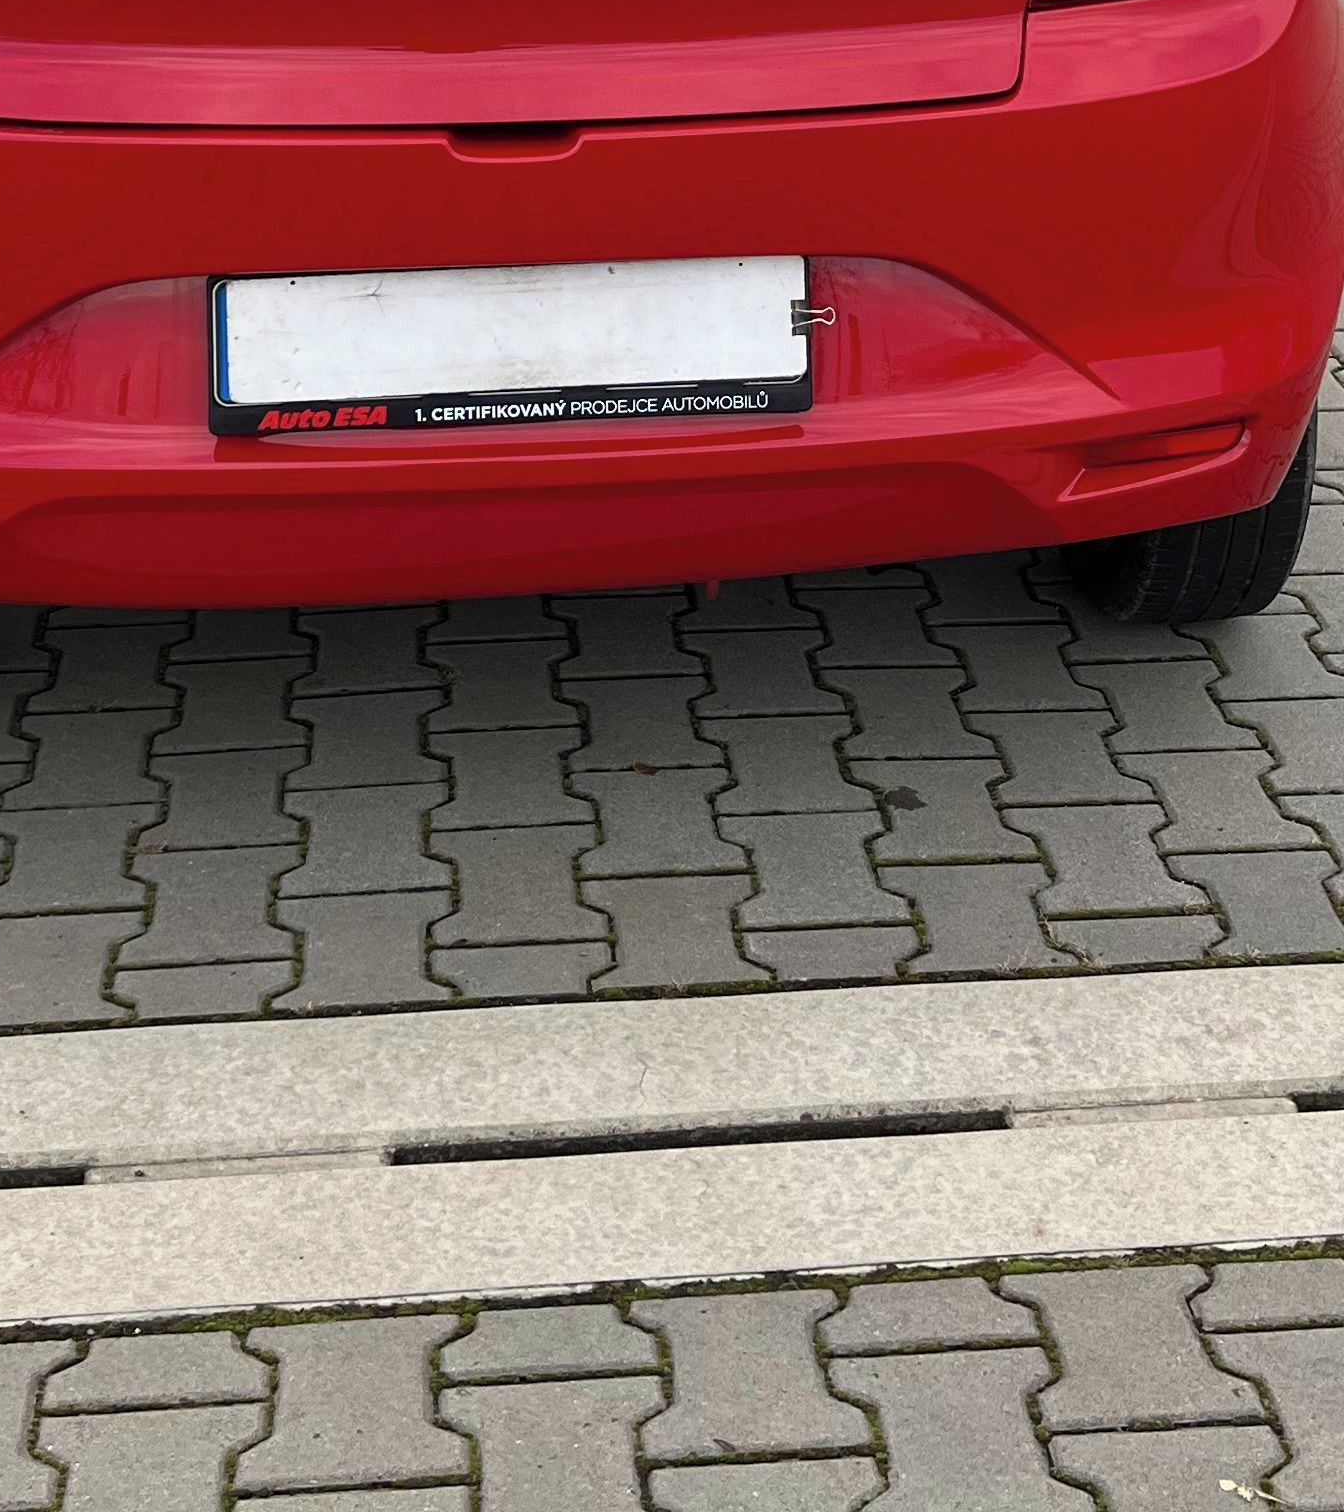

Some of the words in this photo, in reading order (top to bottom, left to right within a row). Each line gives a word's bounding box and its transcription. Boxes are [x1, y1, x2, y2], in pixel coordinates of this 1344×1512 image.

[257, 408, 332, 432] Auto
[332, 405, 389, 427] ESA
[415, 408, 427, 422] 1.
[431, 398, 567, 422] CERTIFIKOVANÝ
[570, 398, 658, 416] PRODEJCE
[661, 390, 769, 412] AUTOMOBILŮ
